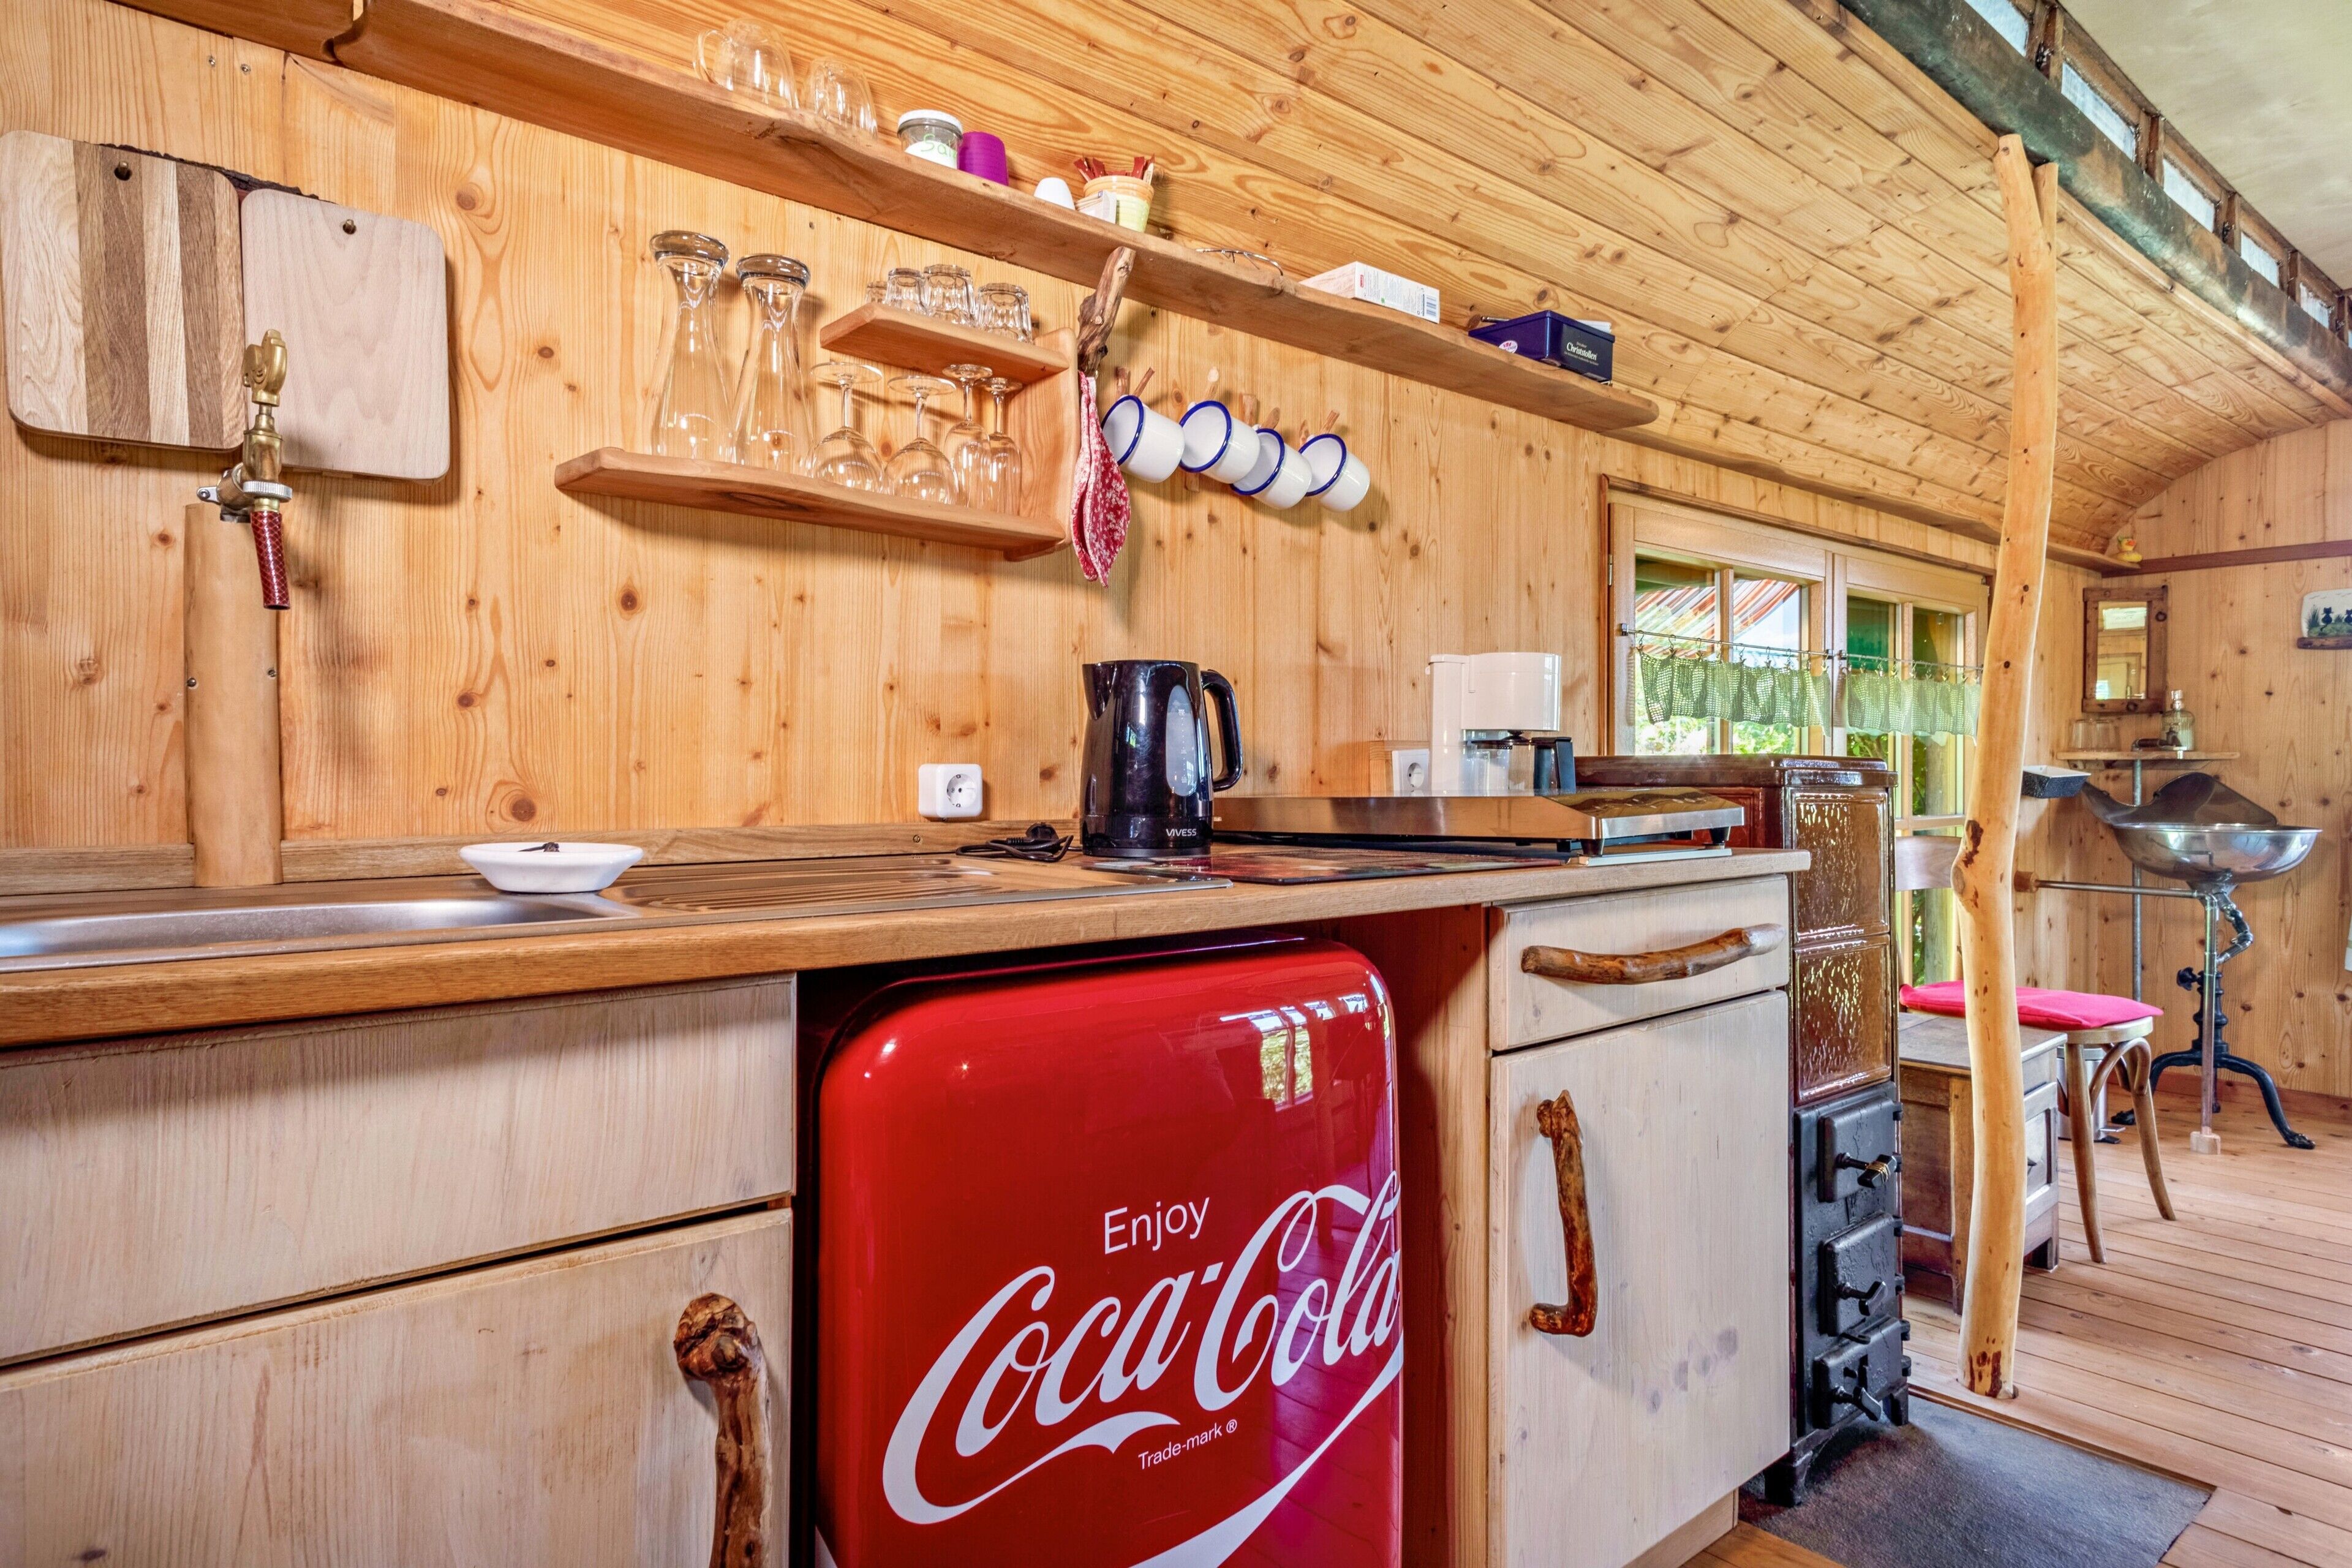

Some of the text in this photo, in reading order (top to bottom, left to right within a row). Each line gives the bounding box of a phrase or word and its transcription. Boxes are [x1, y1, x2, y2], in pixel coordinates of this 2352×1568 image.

[1566, 342, 1597, 360] Christstollen
[1166, 828, 1197, 837] VIVESS
[1104, 1197, 1210, 1254] Enjoy
[883, 1170, 1401, 1525] Coca-Cola
[1137, 1423, 1223, 1469] Trade-mark
